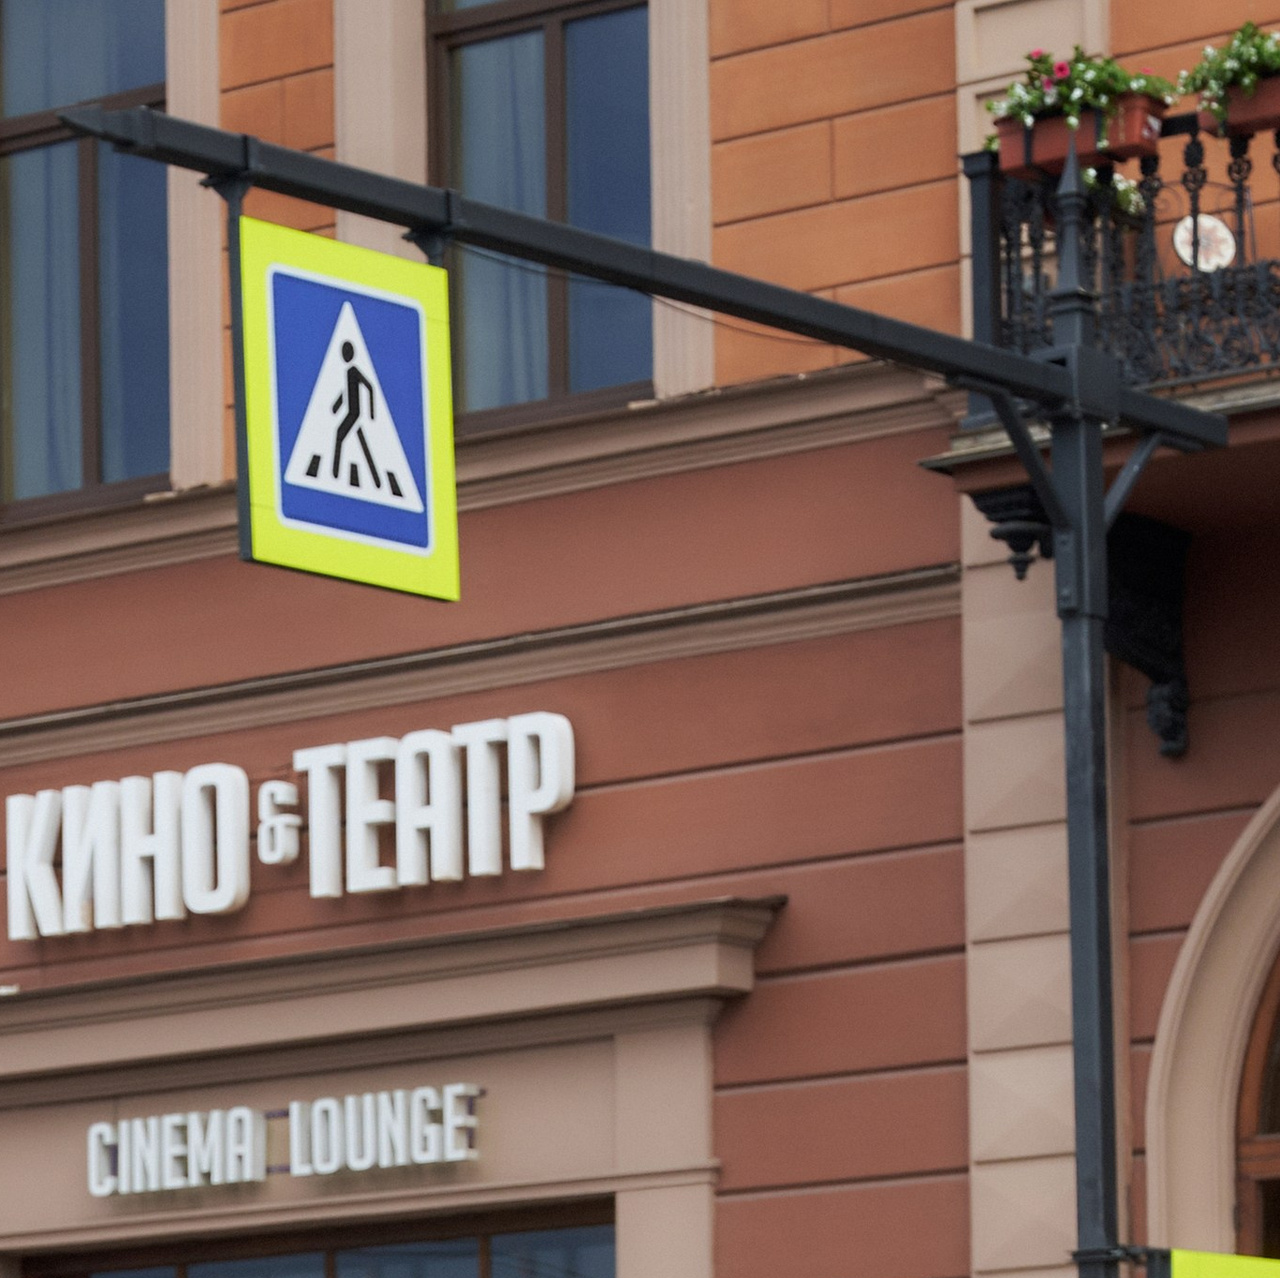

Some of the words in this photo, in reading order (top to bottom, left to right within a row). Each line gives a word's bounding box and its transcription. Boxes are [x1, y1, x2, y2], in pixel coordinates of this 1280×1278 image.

[6, 762, 251, 941] КИНО
[257, 780, 302, 865] &
[293, 711, 576, 899] ТЕАТР
[87, 1106, 267, 1197] CINEMA
[289, 1082, 480, 1177] LOUNGE
